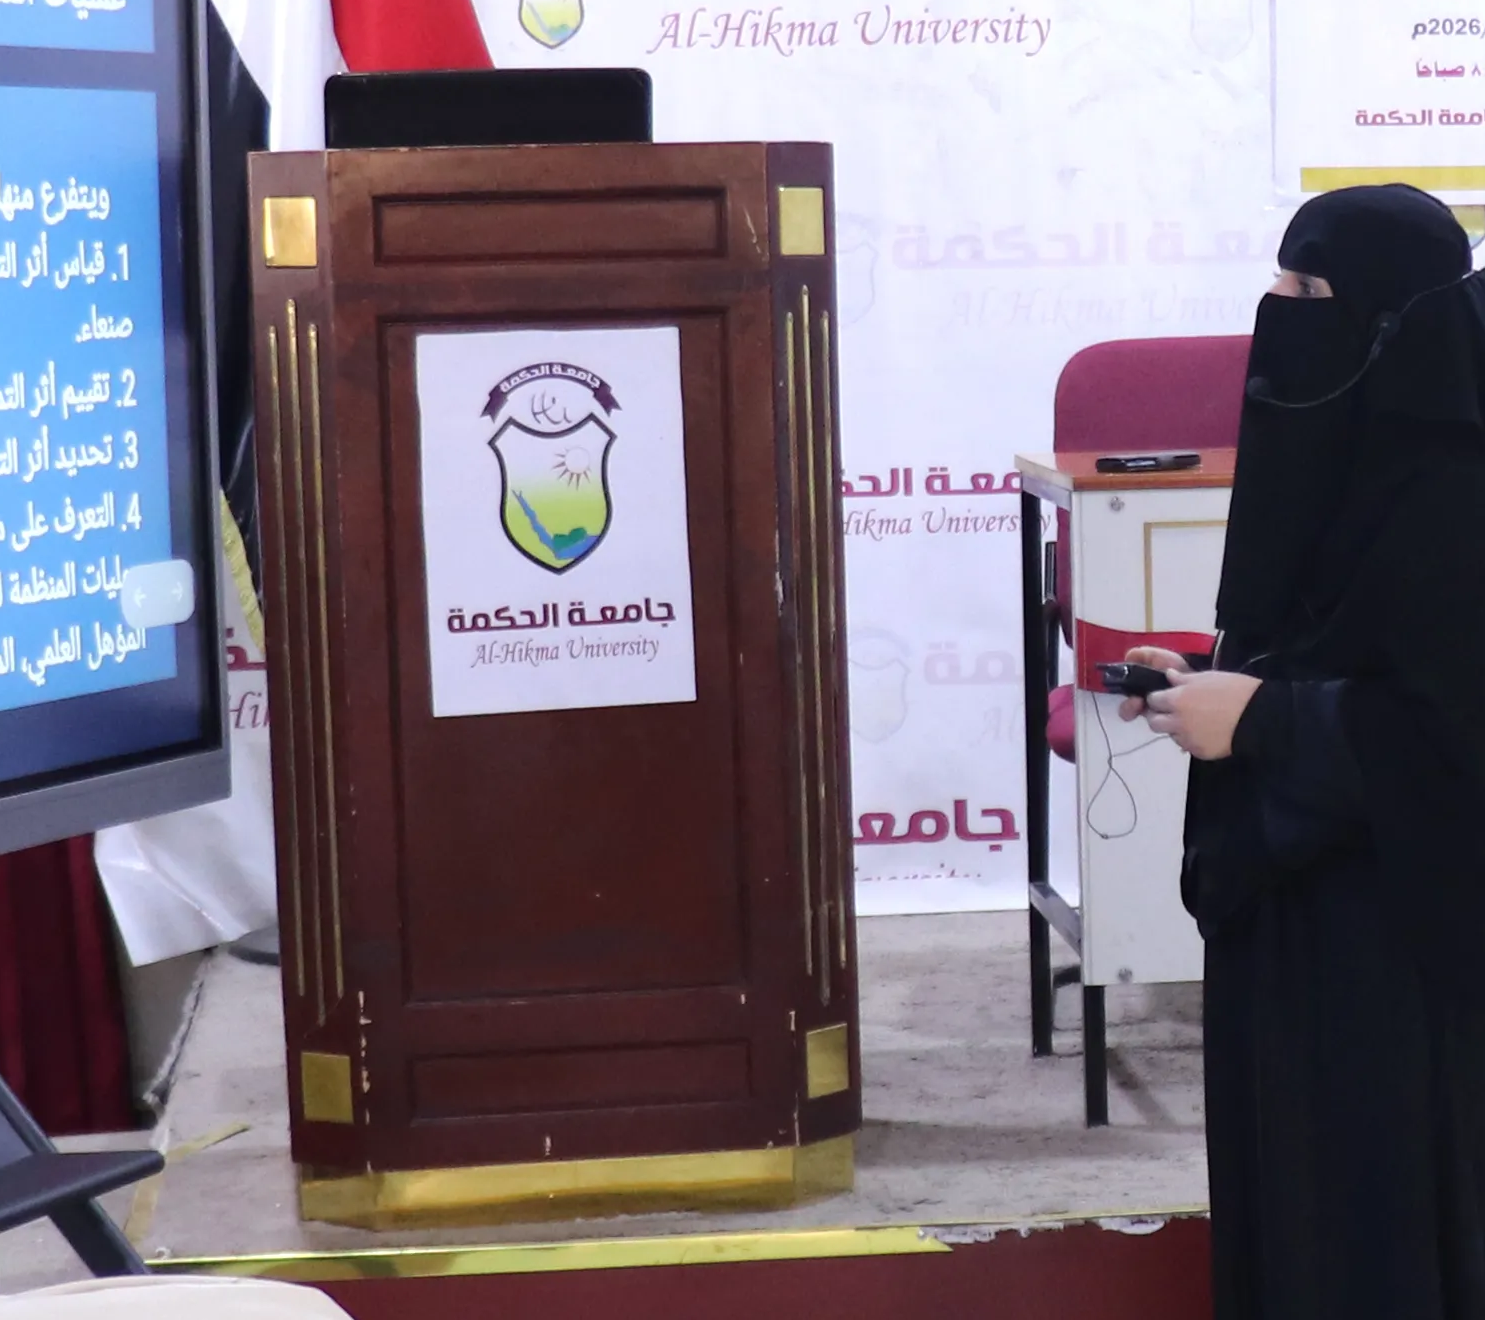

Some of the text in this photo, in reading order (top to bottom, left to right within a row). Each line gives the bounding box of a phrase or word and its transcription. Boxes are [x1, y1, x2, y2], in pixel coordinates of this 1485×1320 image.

[648, 6, 1051, 57] Al-Hikma University
[1355, 109, 1433, 127] الحكمة
[39, 177, 110, 225] ويتفرع
[20, 231, 48, 288] أثر
[53, 240, 105, 289] قياس
[75, 304, 133, 343] صنعاء.
[498, 364, 602, 392] جامعة الحكمة
[446, 597, 676, 634] جامعة الحكمة
[471, 634, 660, 667] Al-Hikma University
